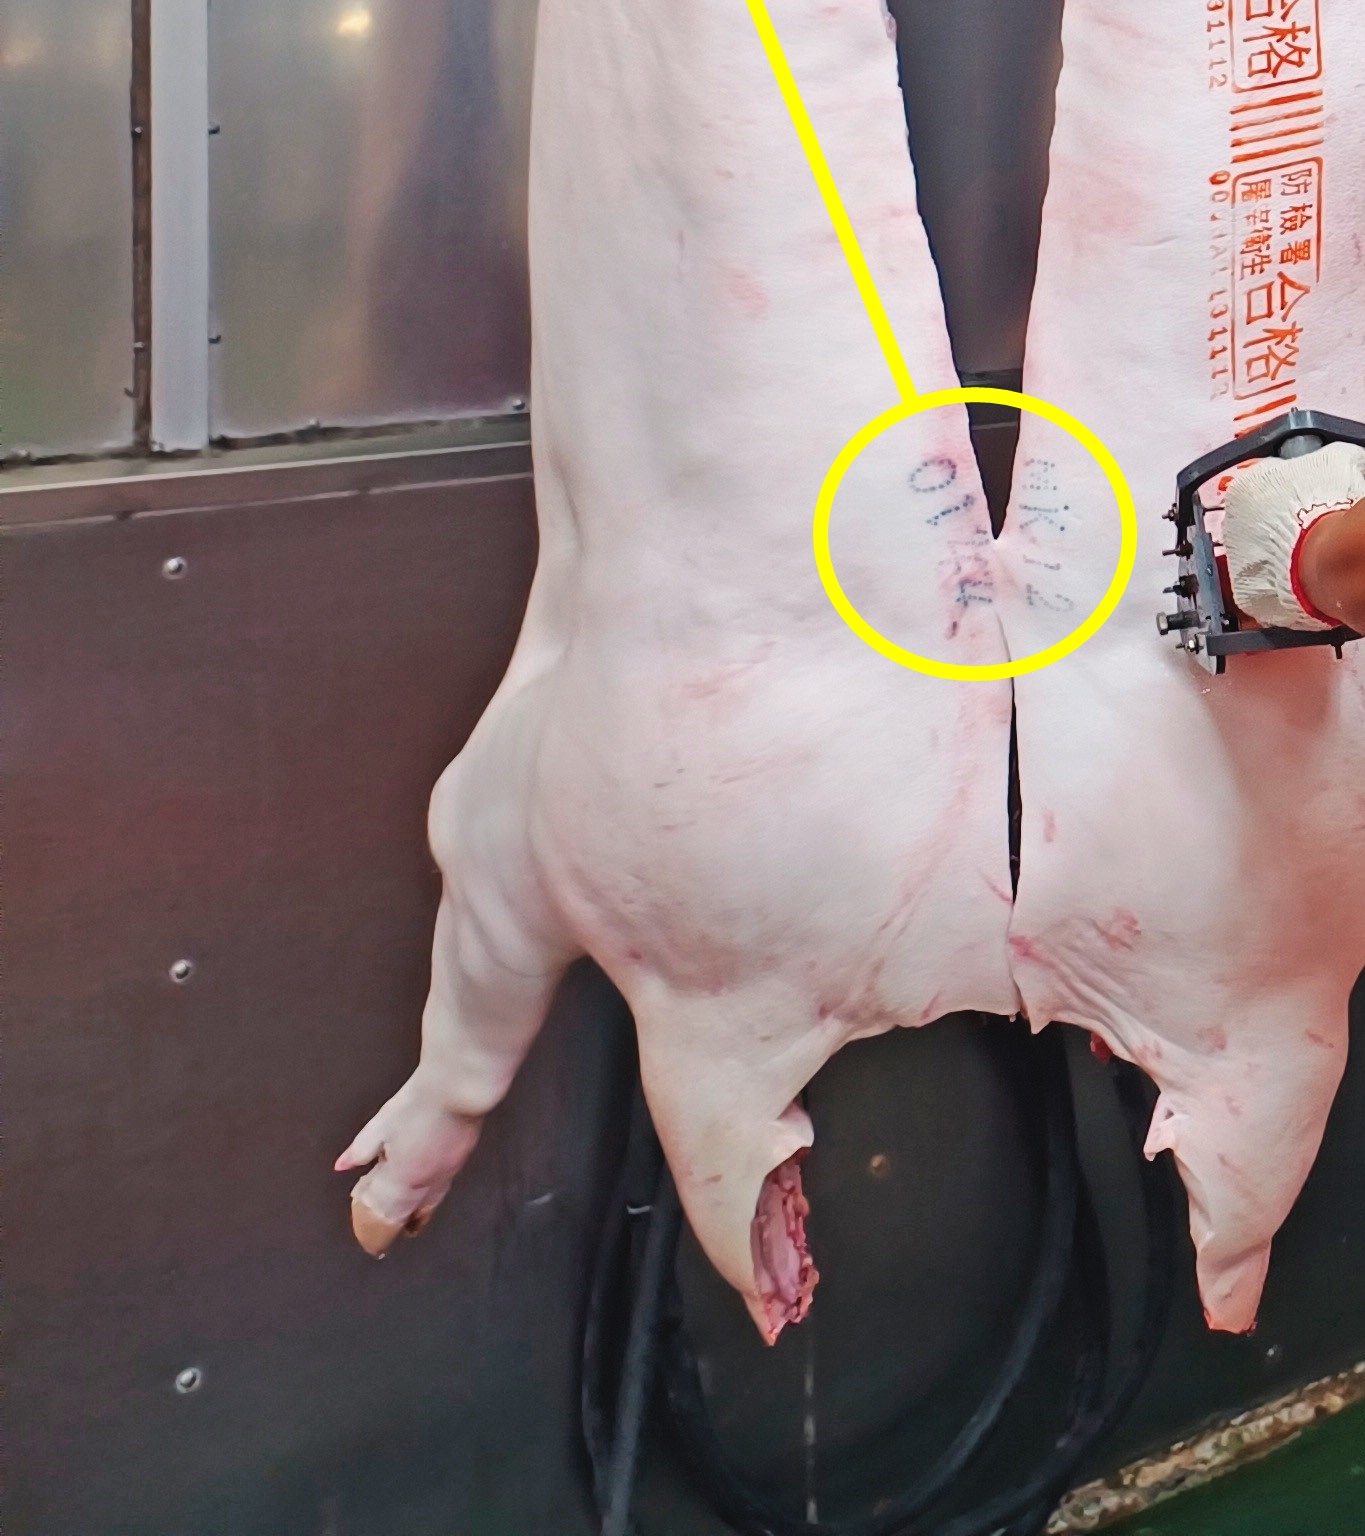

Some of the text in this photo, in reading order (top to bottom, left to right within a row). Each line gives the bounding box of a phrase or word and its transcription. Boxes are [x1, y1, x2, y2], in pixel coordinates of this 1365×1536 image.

[1279, 168, 1313, 265] 防檢署
[1243, 271, 1310, 381] 合格
